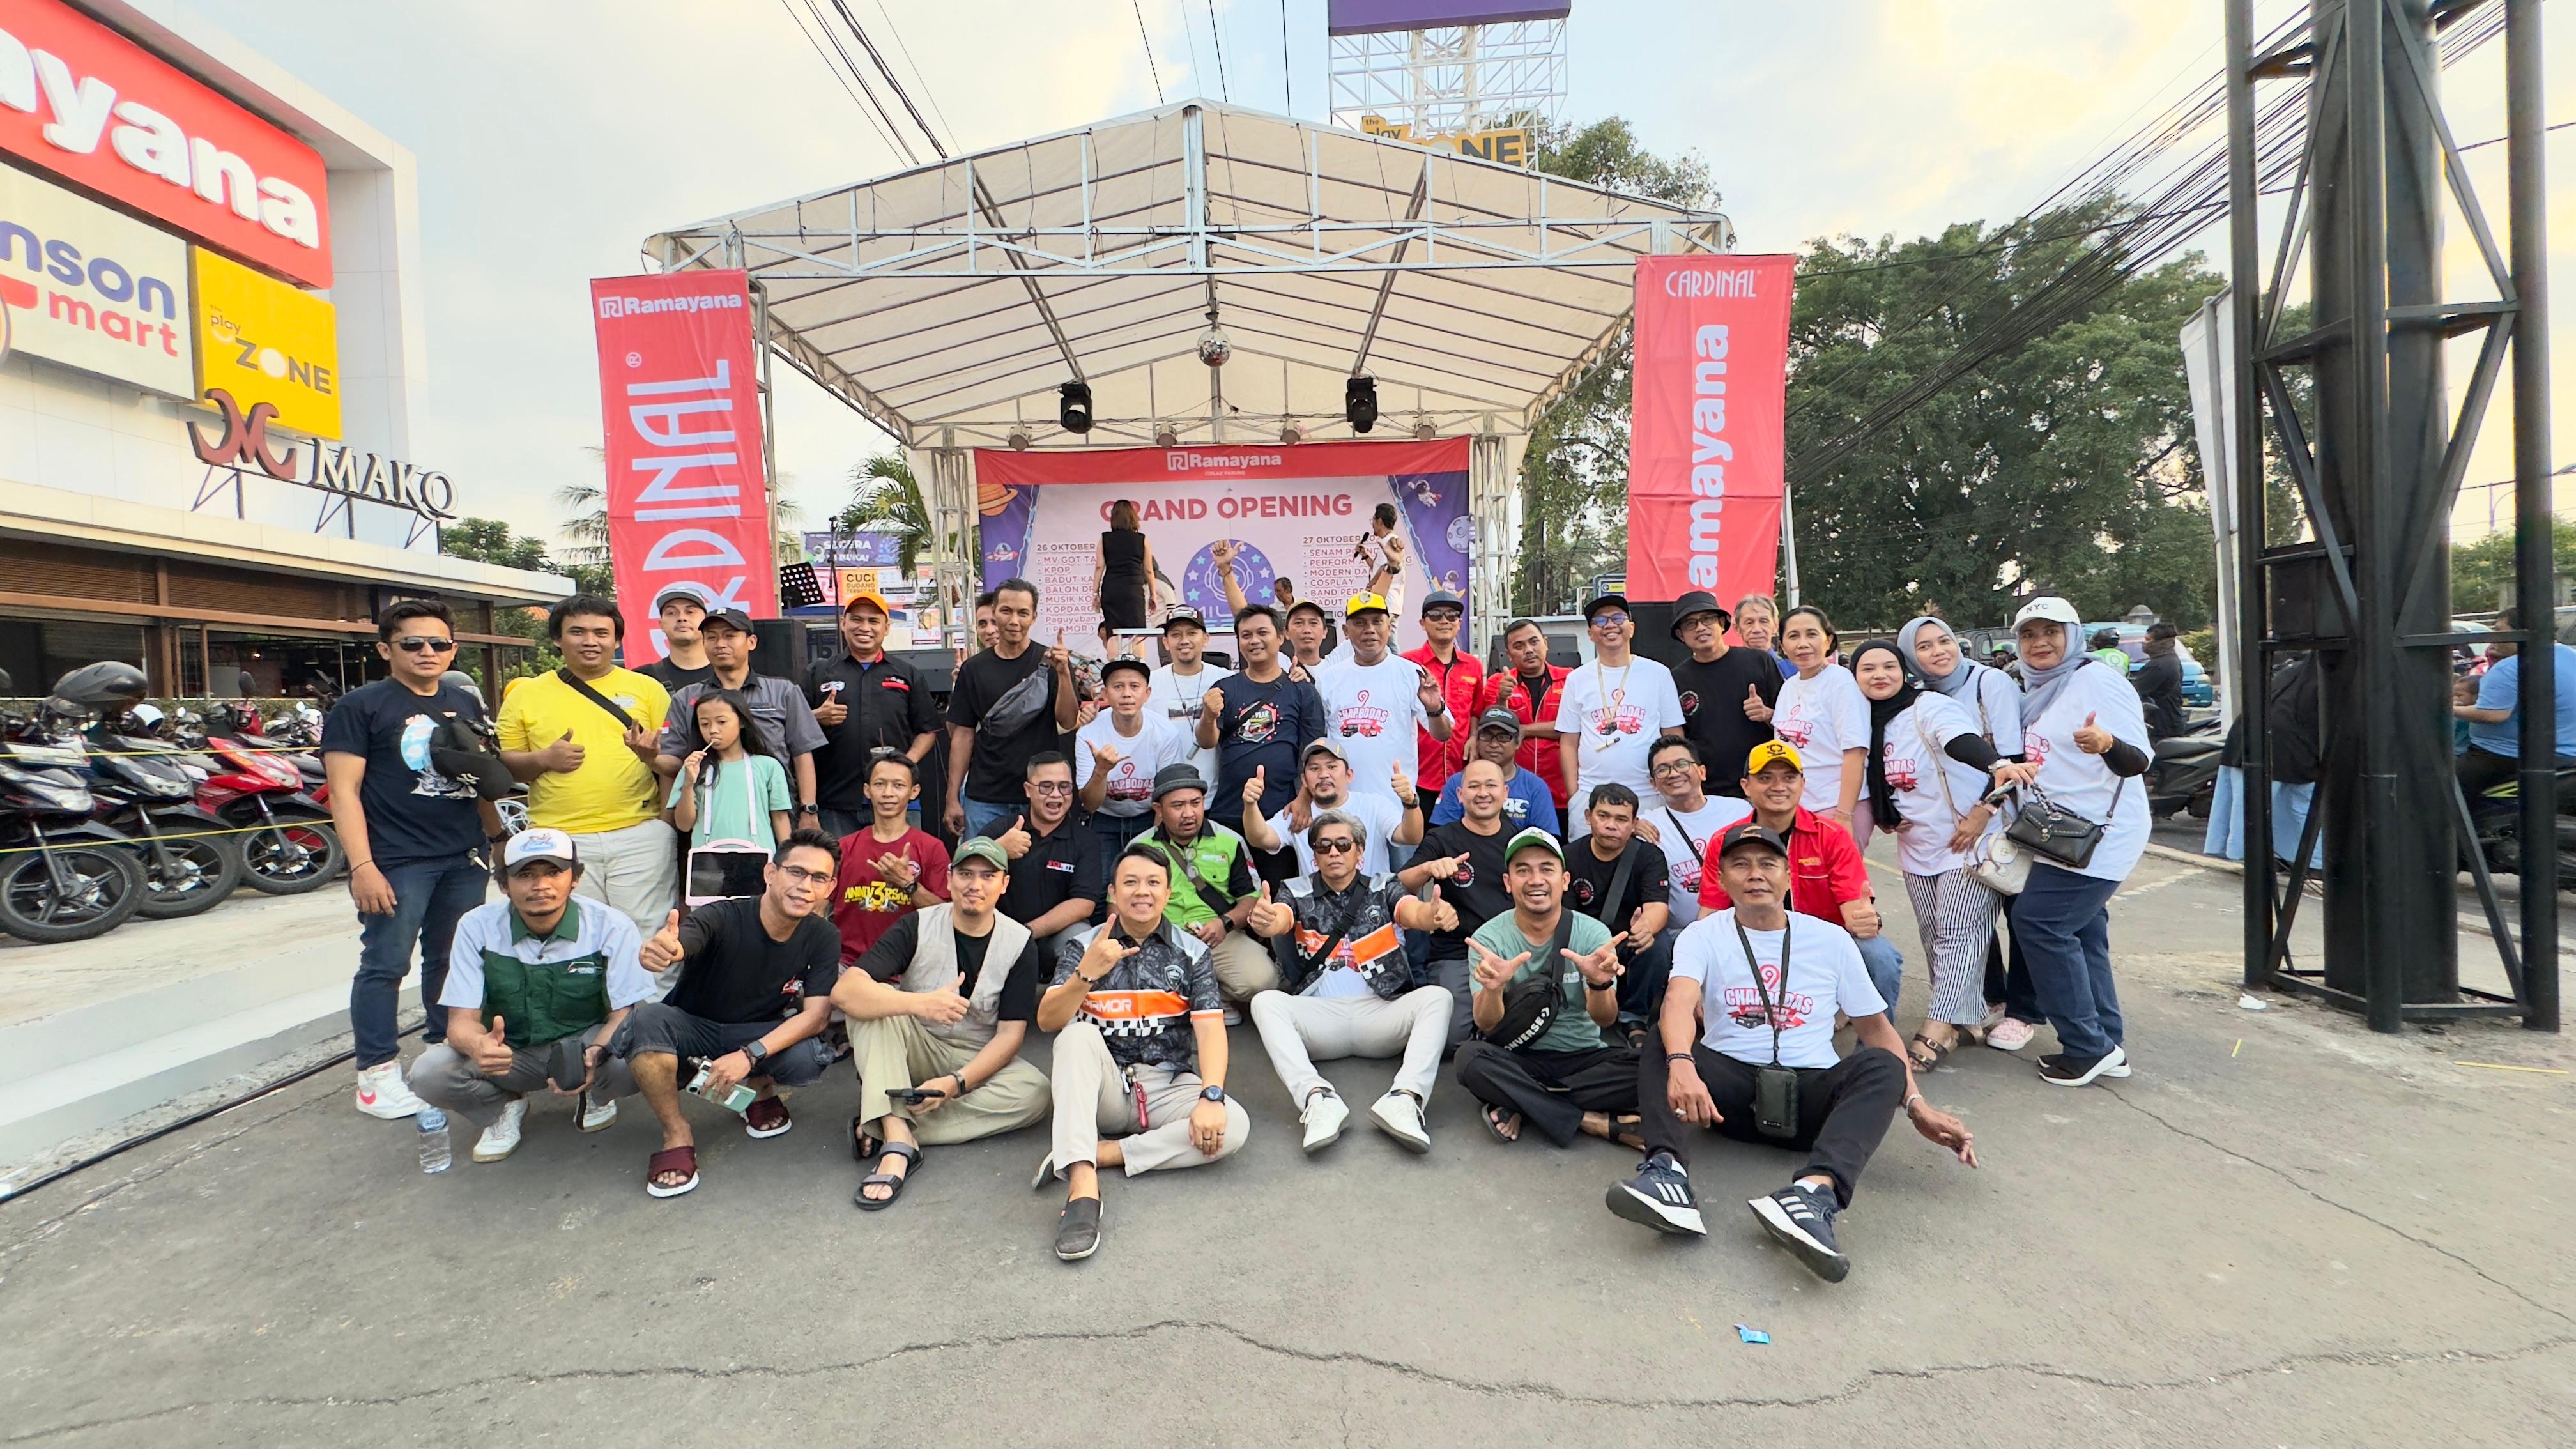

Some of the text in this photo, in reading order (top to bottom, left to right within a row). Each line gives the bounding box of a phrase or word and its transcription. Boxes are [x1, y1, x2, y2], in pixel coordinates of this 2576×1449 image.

[1665, 270, 1756, 298] CARDINAL
[624, 293, 742, 315] Ramayana
[48, 291, 178, 357] mart
[211, 314, 241, 336] play
[1189, 454, 1282, 469] Ramayana
[1688, 324, 1733, 589] amayana
[308, 438, 458, 521] MAKO
[1217, 493, 1352, 519] OPENING
[847, 574, 875, 583] CUCI
[2027, 603, 2049, 613] NYC
[1046, 616, 1096, 624] Paguyuban
[1255, 710, 1269, 719] YEAR
